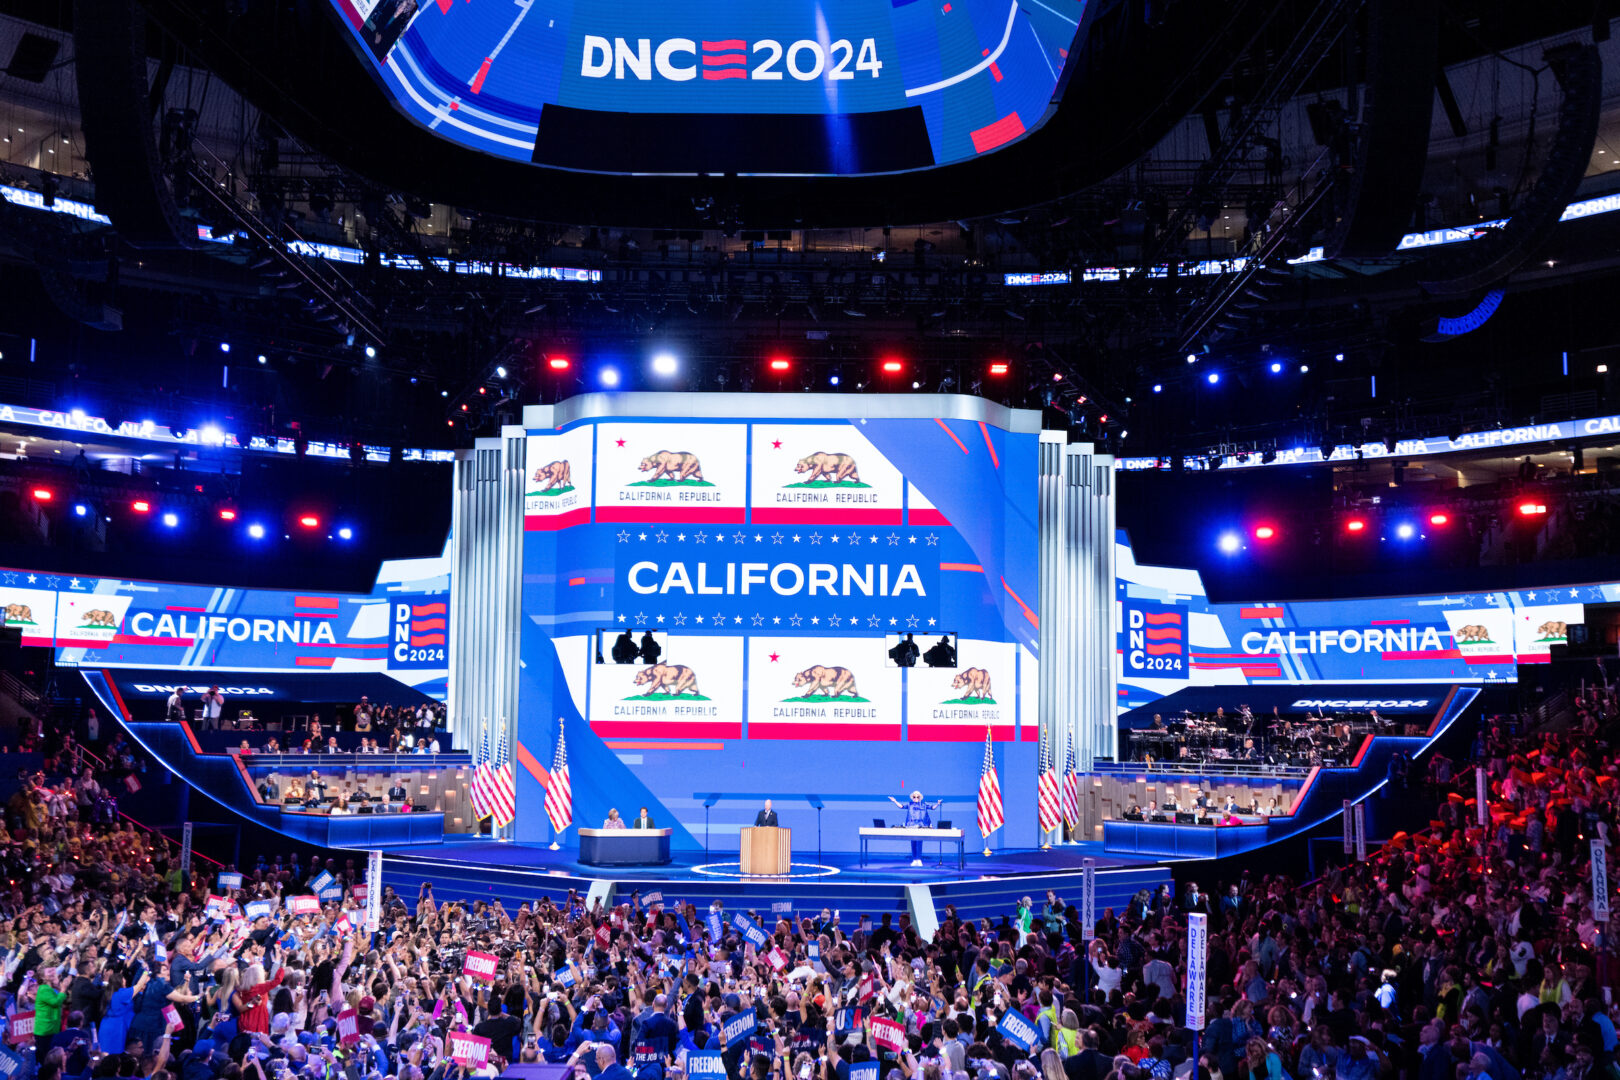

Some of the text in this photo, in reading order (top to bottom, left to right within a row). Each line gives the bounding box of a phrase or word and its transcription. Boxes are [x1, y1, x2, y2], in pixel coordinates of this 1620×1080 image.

[581, 35, 883, 81] DNC 2024
[1040, 273, 1067, 282] 2024
[619, 491, 721, 502] CALIFORNIA REPUBLIC
[776, 493, 878, 504] CALIFORNIA REPUBLIC
[627, 561, 927, 597] CALIFORNIA
[131, 612, 336, 644] CALIFORNIA
[1241, 627, 1443, 654] CALIFORNIA
[409, 649, 444, 661] 2024
[1146, 658, 1182, 670] 2024
[614, 705, 718, 717] CALIFORNIA REPUBLIC
[773, 707, 877, 718] CALIFORNIA REPUBLIC
[933, 709, 979, 719] CALIFORNIA
[1594, 849, 1606, 910] OKLAHOMA
[771, 902, 793, 913] FREEDOM
[746, 926, 766, 947] FREEDOM
[465, 955, 495, 975] FREEDOM
[1188, 928, 1197, 1013] DELAWARE
[724, 1014, 754, 1043] FREEDOM
[836, 1008, 862, 1031] USA
[1002, 1013, 1038, 1045] FREEDOM
